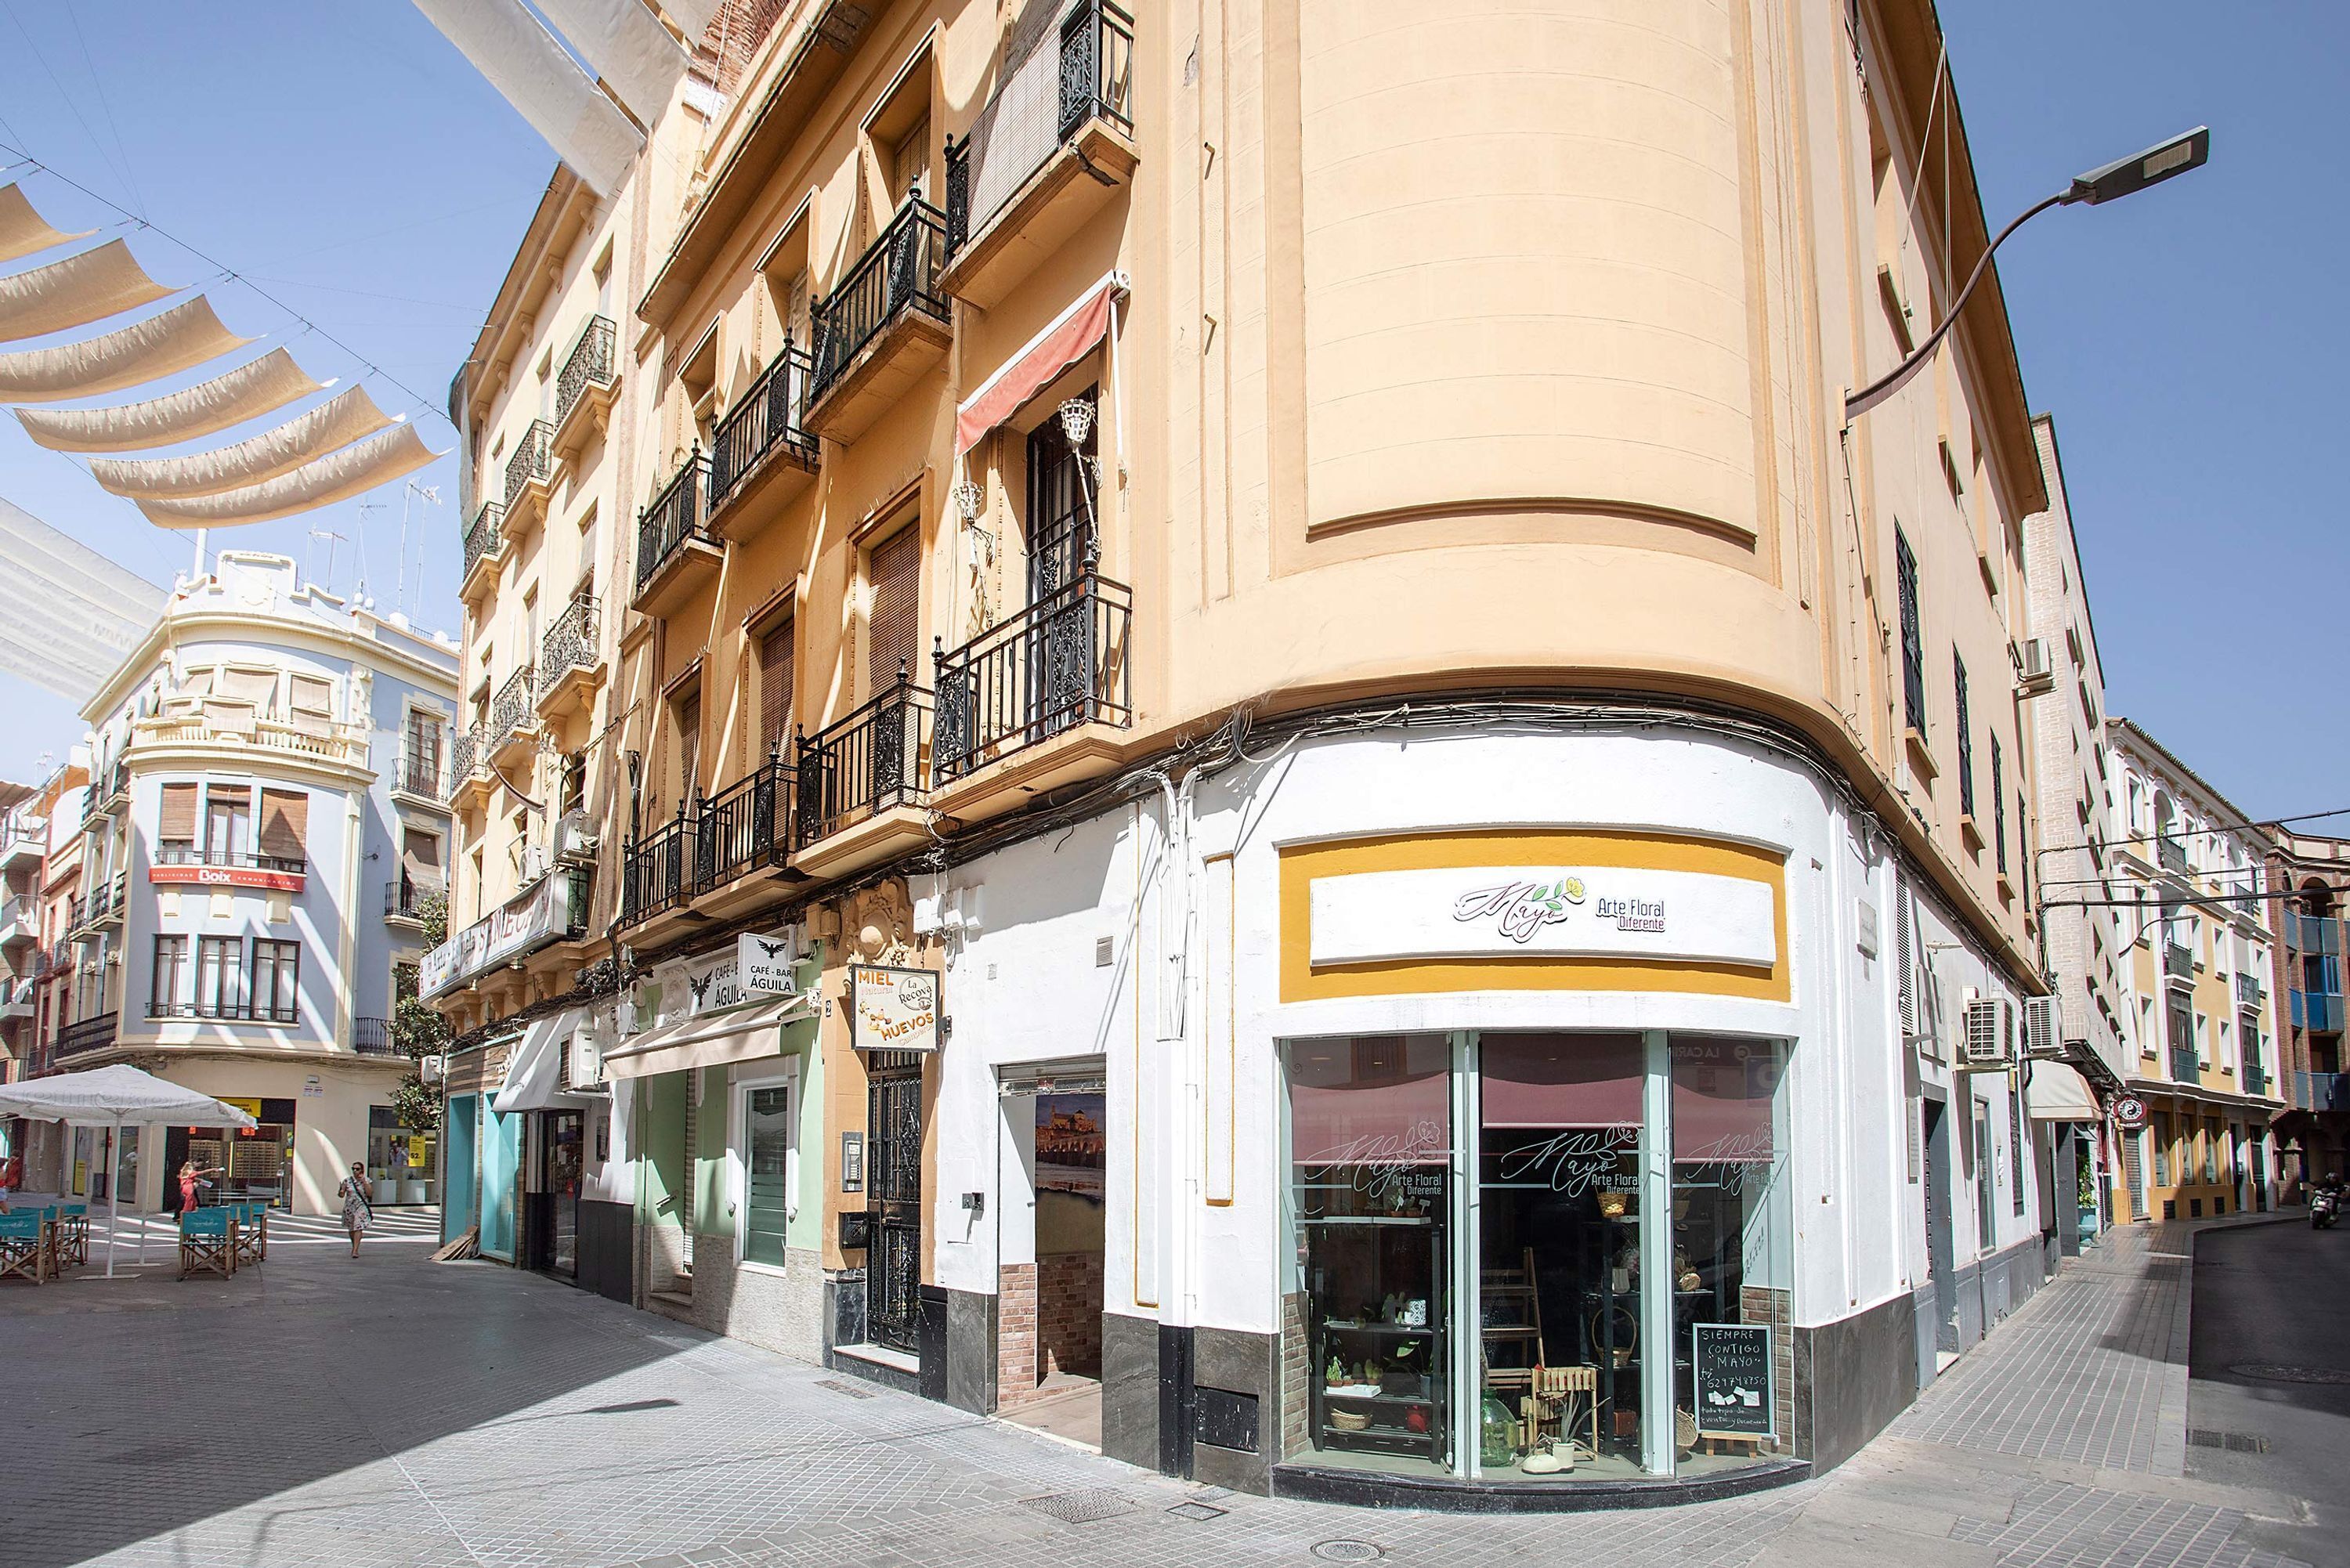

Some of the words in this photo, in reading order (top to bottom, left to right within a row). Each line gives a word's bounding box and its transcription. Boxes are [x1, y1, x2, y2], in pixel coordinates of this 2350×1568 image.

[198, 869, 231, 882] Boix
[1458, 881, 1564, 938] Mayo
[1599, 898, 1626, 915] Arte
[1630, 899, 1665, 917] Floral
[1619, 916, 1665, 930] Diferente
[715, 959, 730, 981] CAFÉ
[750, 965, 769, 975] CAFÉ
[776, 968, 792, 977] BAR
[750, 974, 792, 992] ÁGUILA
[858, 970, 895, 986] MIEL
[908, 980, 916, 988] La
[898, 985, 932, 1004] Recova
[880, 1012, 935, 1042] HUEVOS
[1500, 1133, 1618, 1198] Mayo
[1392, 1174, 1413, 1186] Arte
[1415, 1174, 1441, 1186] Floral
[1592, 1173, 1611, 1186] Arte
[1408, 1186, 1441, 1195] Diferente
[1701, 1330, 1754, 1340] SIEMPRE
[1708, 1343, 1760, 1356] CONTIGO
